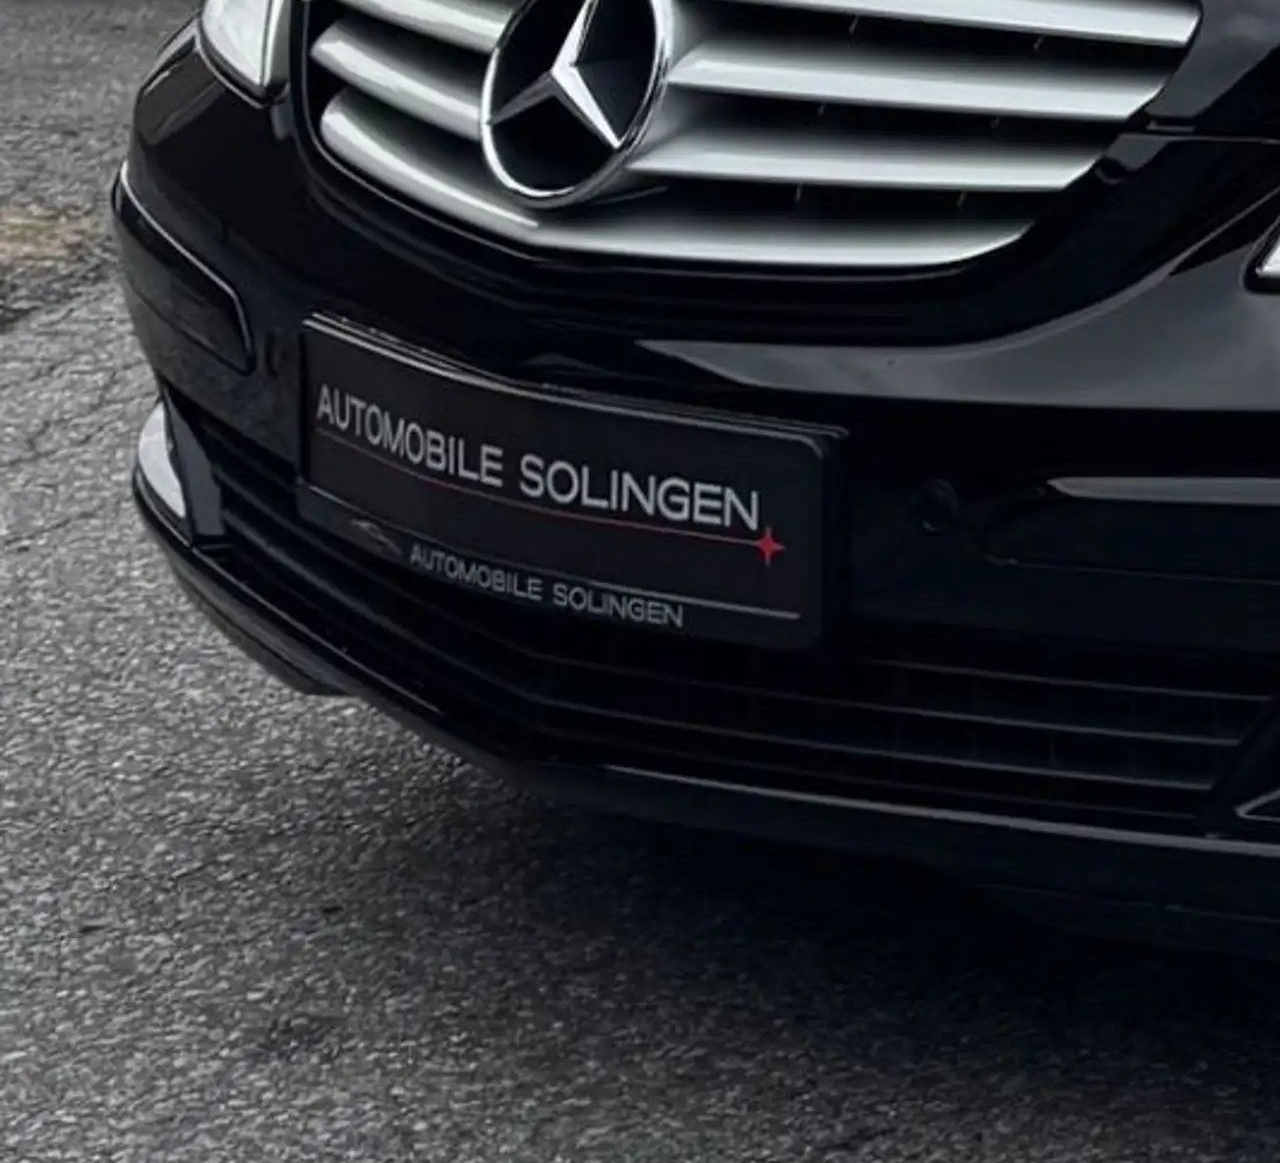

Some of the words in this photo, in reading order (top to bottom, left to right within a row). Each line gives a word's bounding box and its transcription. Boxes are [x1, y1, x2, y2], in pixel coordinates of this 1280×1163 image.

[316, 384, 503, 488] AUTOMOBILE
[519, 453, 759, 531] SOLINGEN
[409, 543, 543, 603] AUTOMOBILE
[552, 583, 684, 629] SOLINGEN
